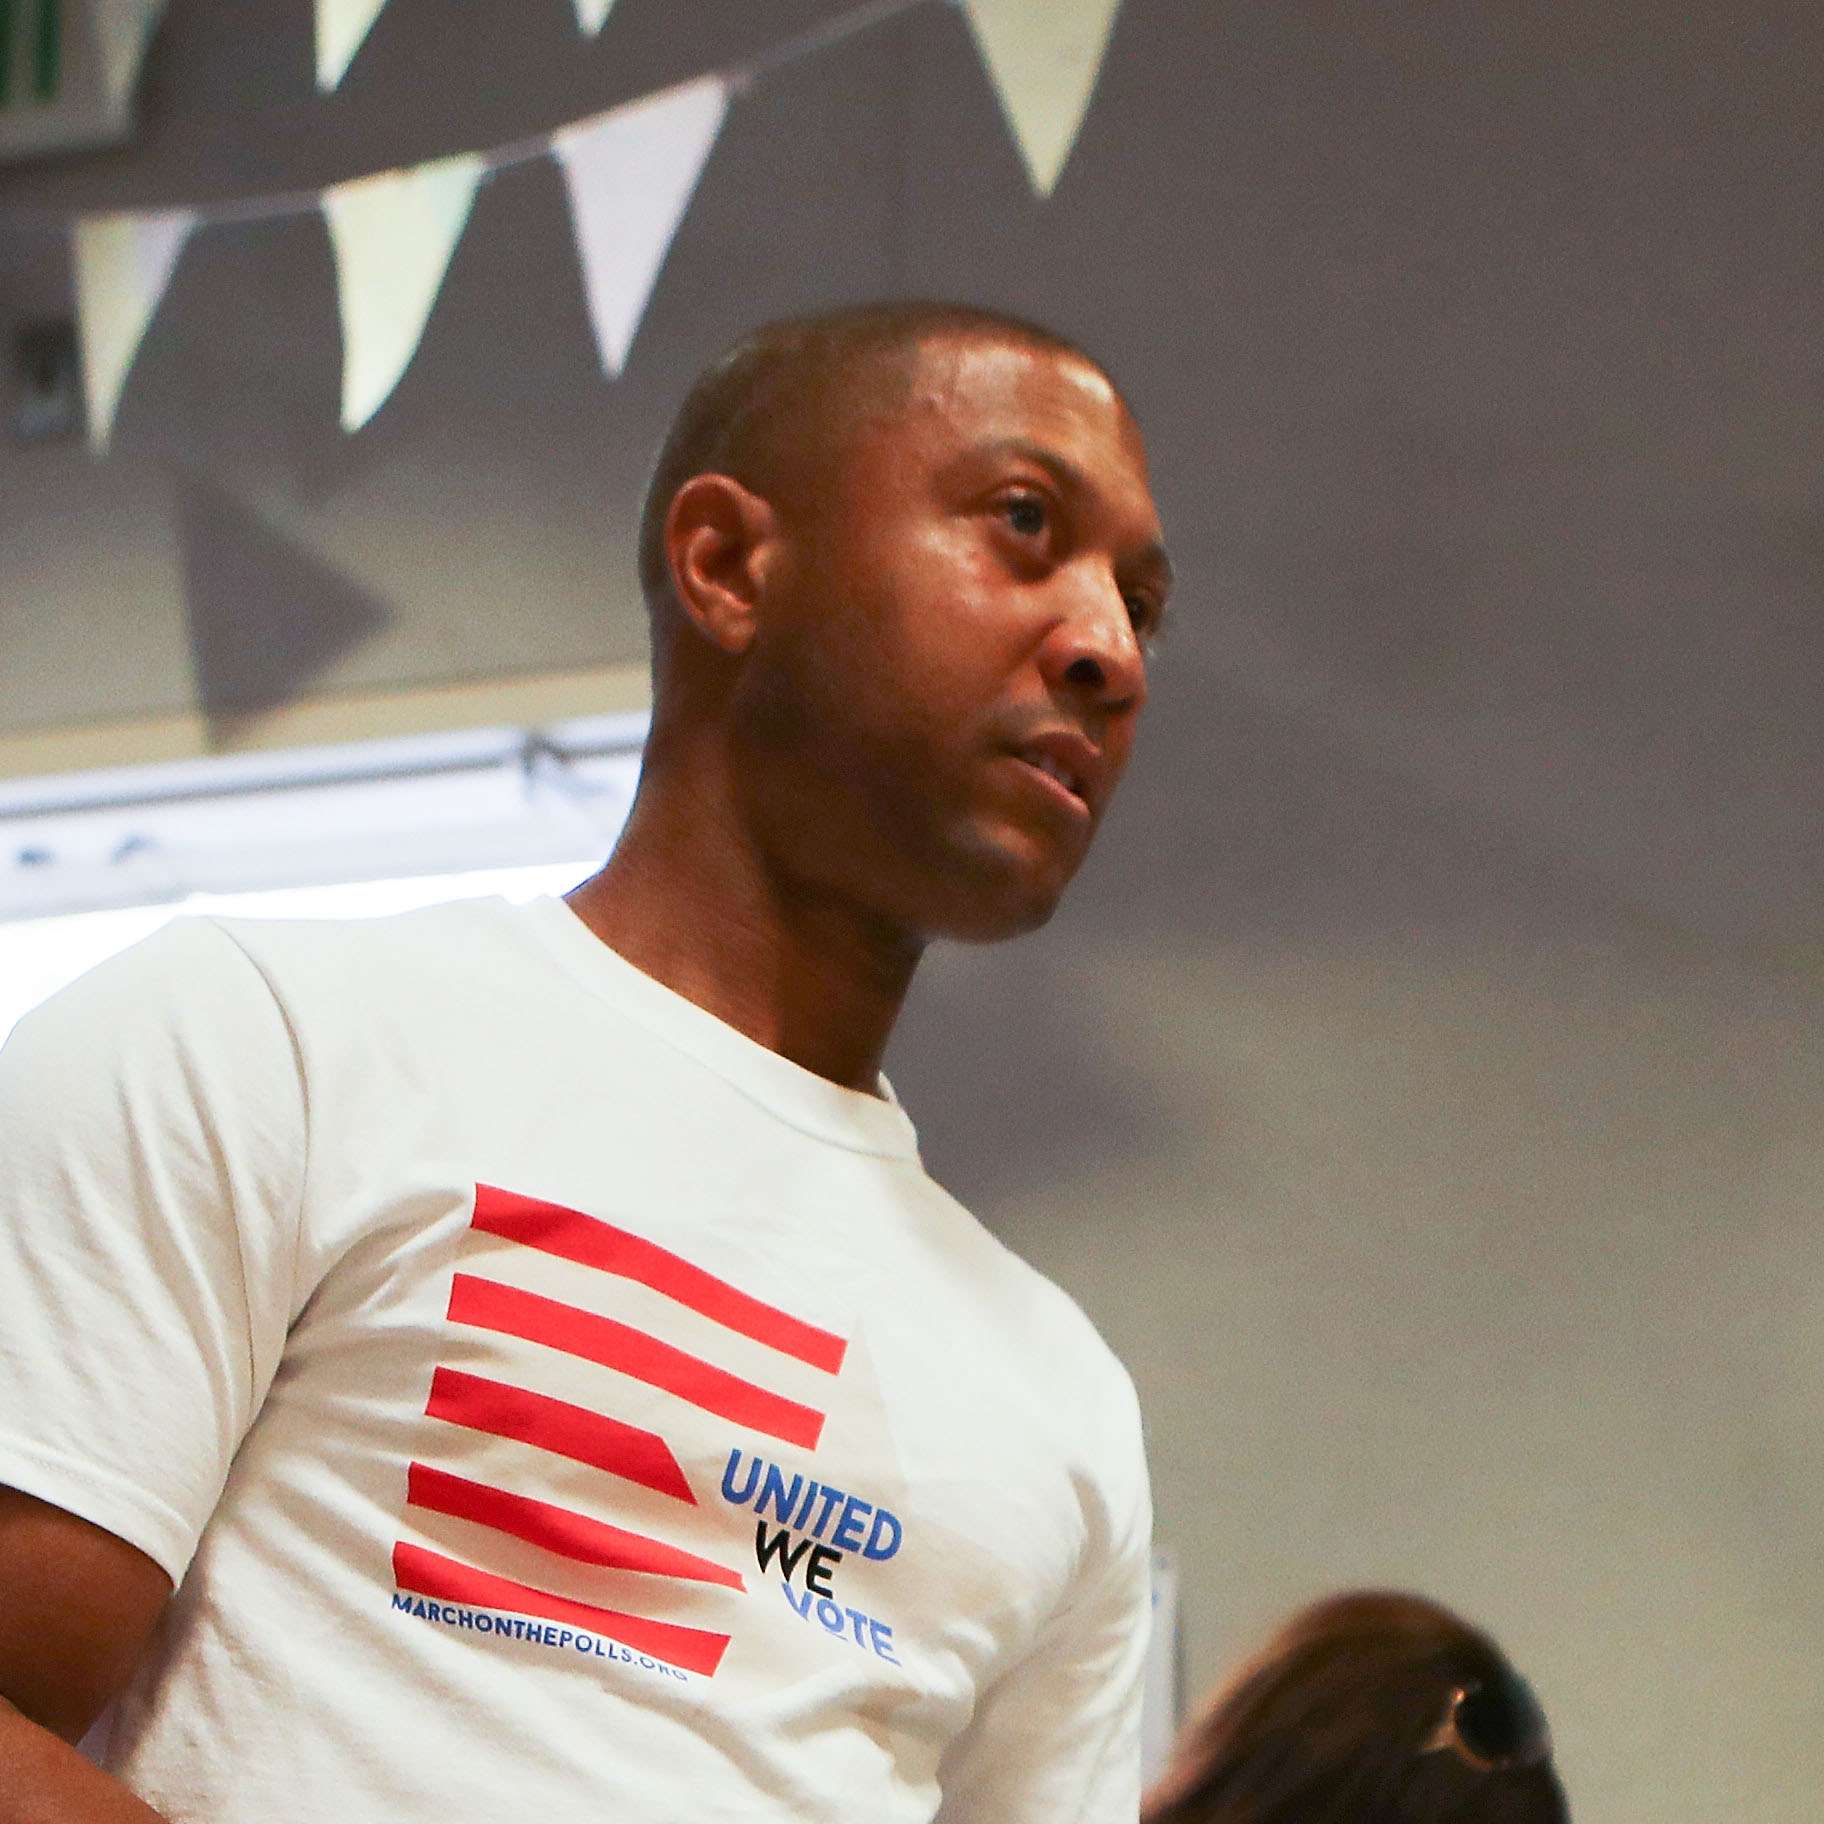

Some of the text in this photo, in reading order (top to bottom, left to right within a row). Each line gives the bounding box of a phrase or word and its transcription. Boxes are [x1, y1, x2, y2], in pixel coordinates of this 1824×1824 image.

[721, 1448, 903, 1561] UNITED
[755, 1519, 843, 1599] WE
[391, 1592, 688, 1682] MARCHONTHEPOLLS.ORG
[781, 1581, 902, 1667] VOTE
